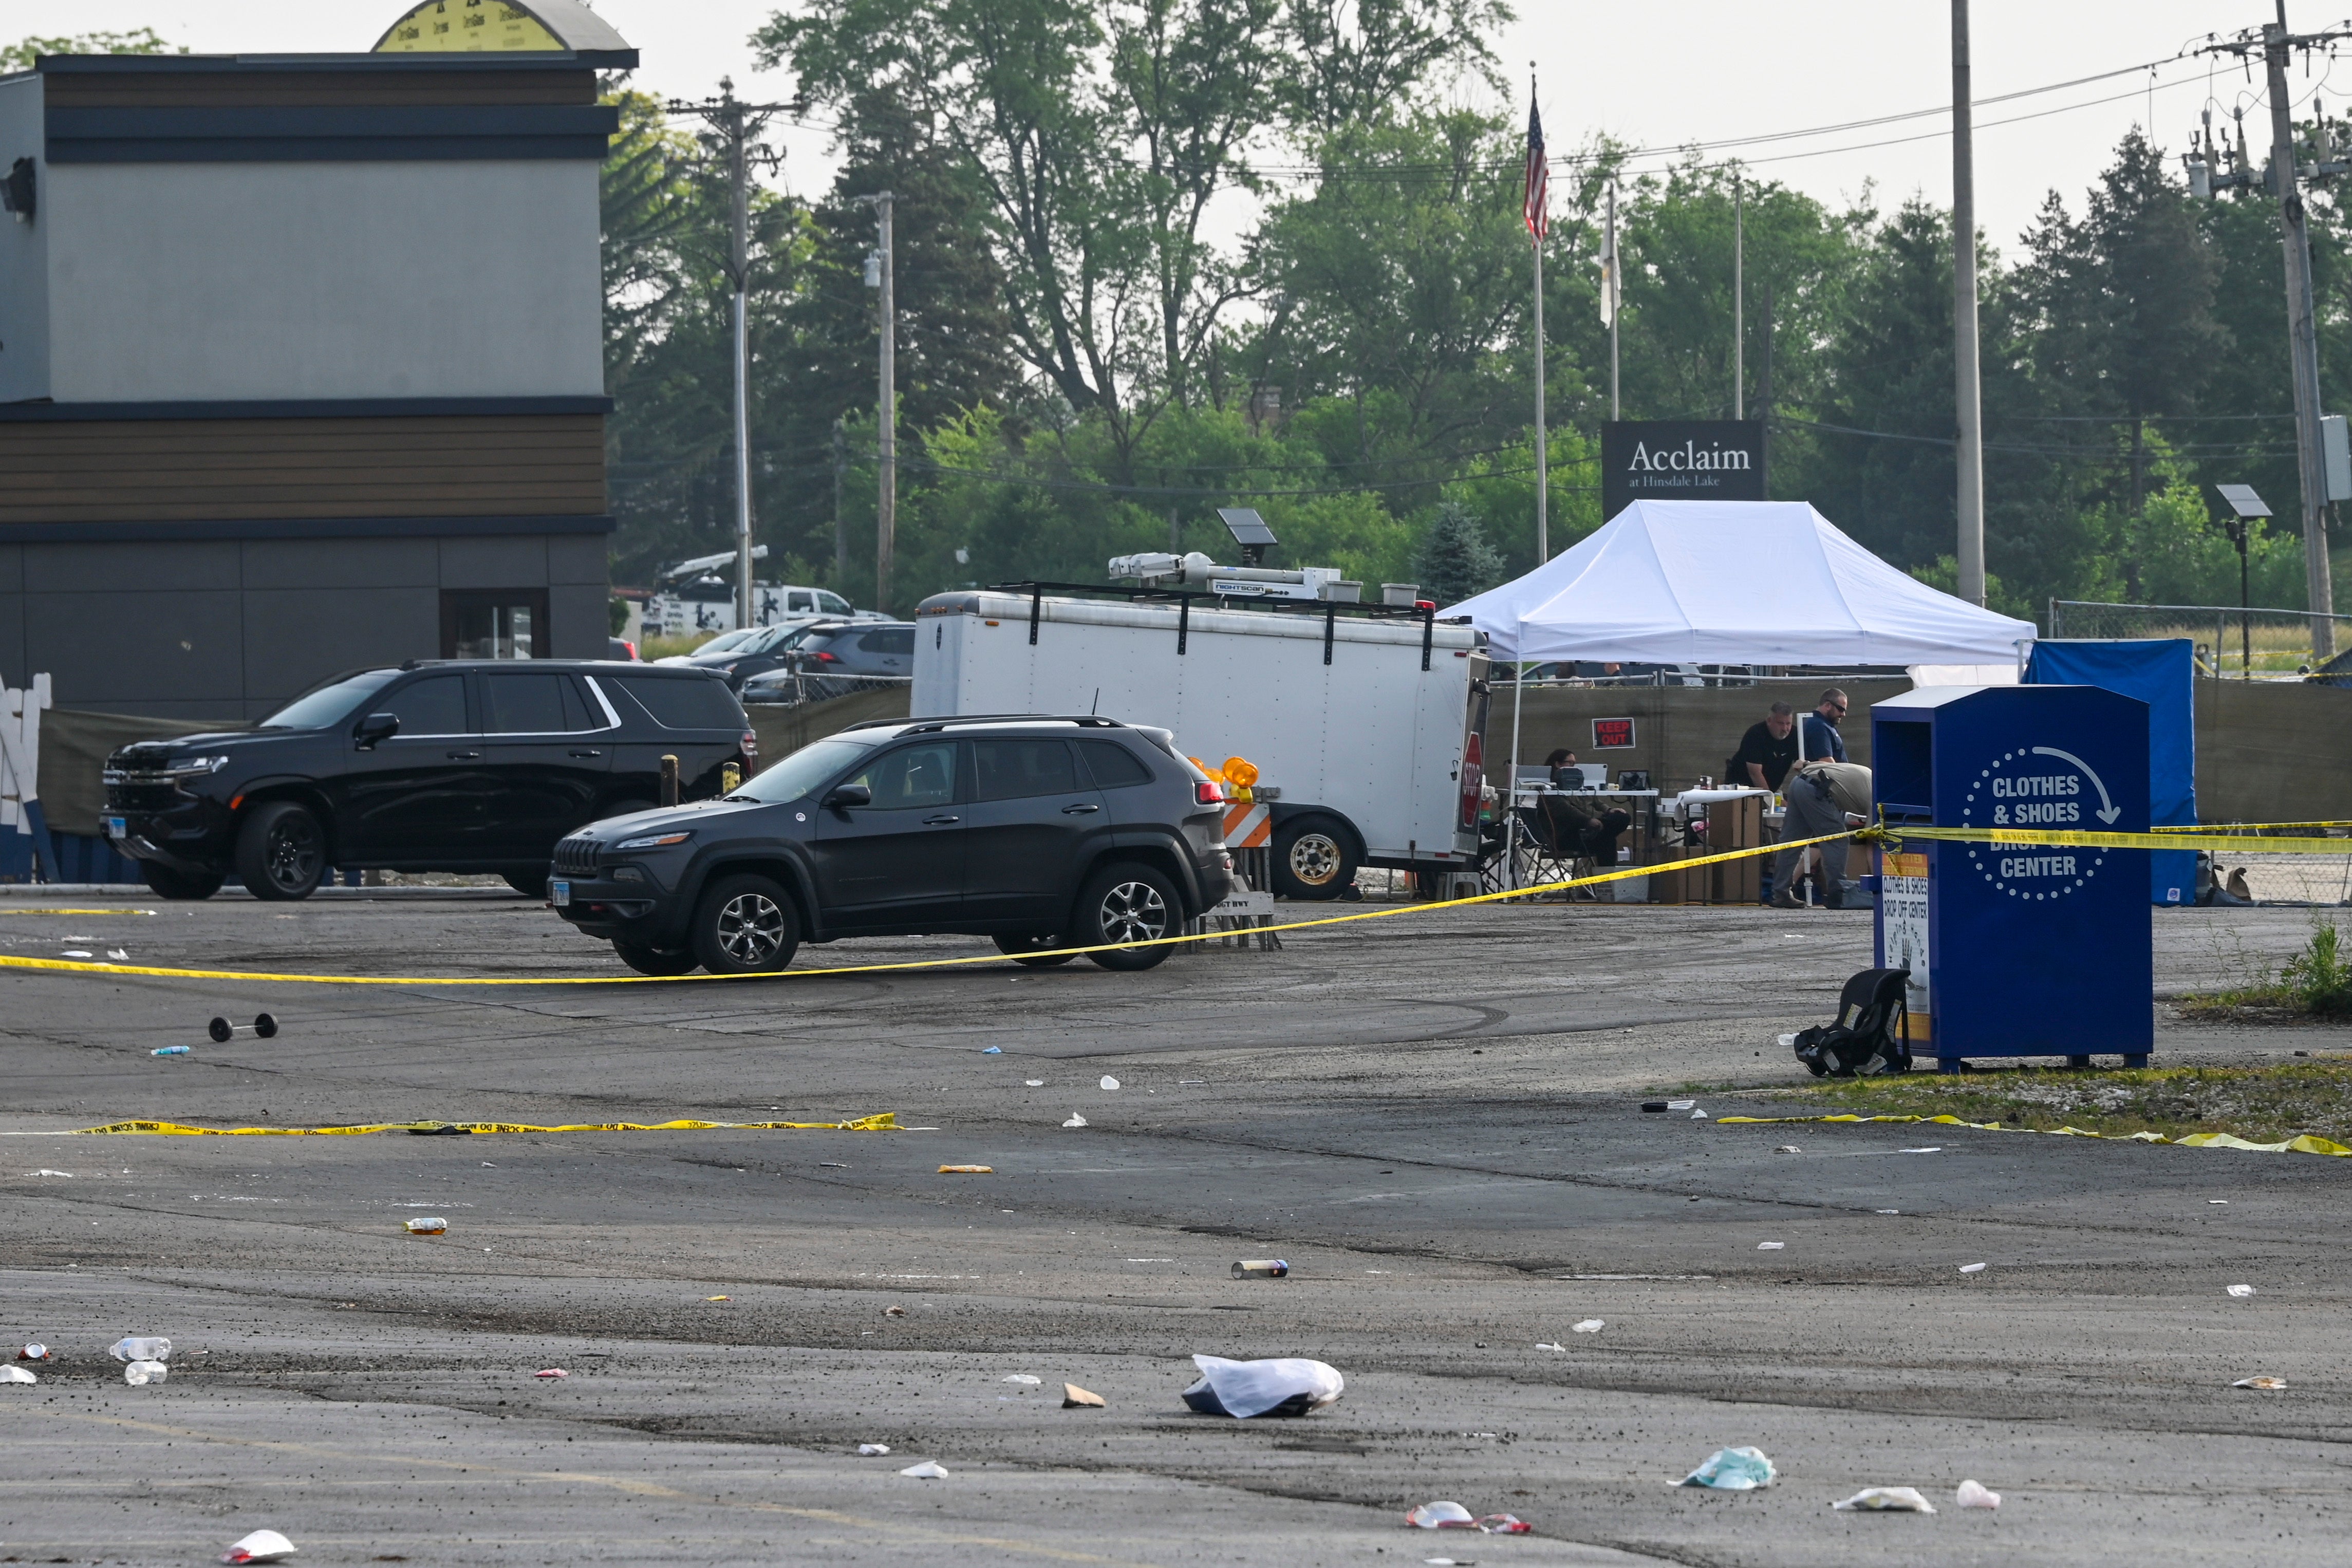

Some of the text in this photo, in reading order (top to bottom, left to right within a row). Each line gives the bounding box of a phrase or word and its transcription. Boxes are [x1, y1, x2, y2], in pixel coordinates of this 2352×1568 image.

[1628, 440, 1751, 471] Acclaim
[1644, 475, 1691, 487] Hinsdale
[1695, 475, 1720, 487] Lake
[1597, 721, 1630, 733] KEEP
[1602, 734, 1627, 745] OUT
[1463, 762, 1480, 796] STOP
[1992, 775, 2080, 797] CLOTHES
[1994, 802, 2080, 824] & SHOES
[2001, 856, 2076, 878] CENTER
[1883, 876, 1927, 895] CLOTHES & SHOES
[1884, 899, 1927, 919] DROP OFF CENTER
[109, 1123, 134, 1133] SCENE
[135, 1123, 159, 1131] CRIME
